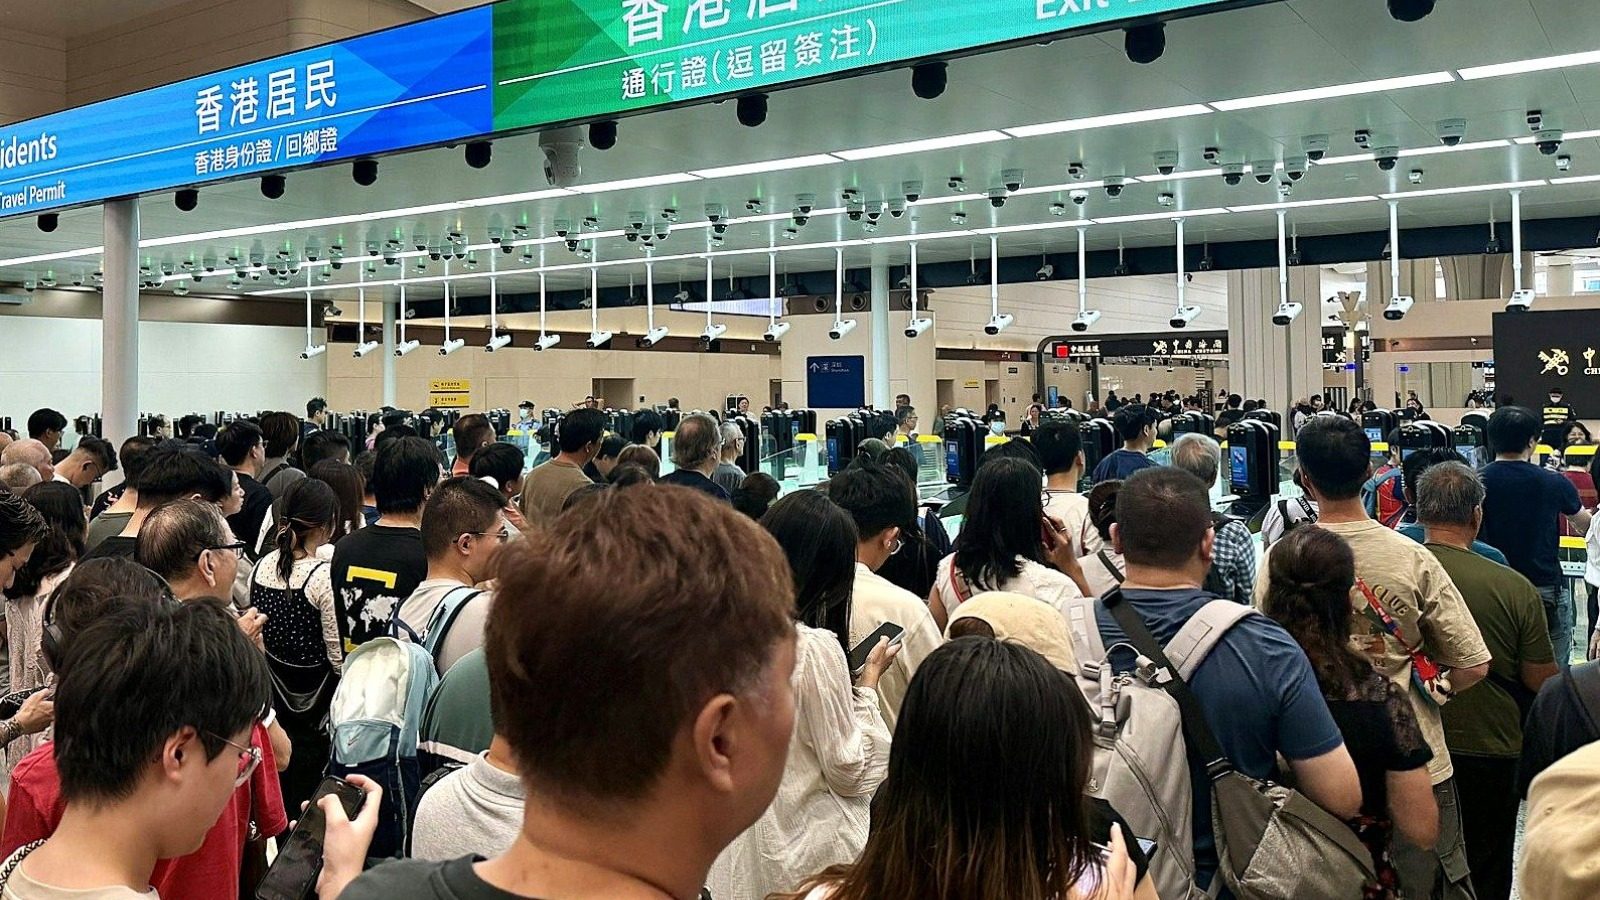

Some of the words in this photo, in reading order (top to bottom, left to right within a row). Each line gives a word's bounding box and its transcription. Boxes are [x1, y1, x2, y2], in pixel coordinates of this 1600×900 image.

[621, 18, 877, 101] 通行證(逗留簽注)
[195, 59, 337, 135] 香港居民
[29, 179, 66, 205] Permit
[1371, 584, 1410, 616] CLUB
